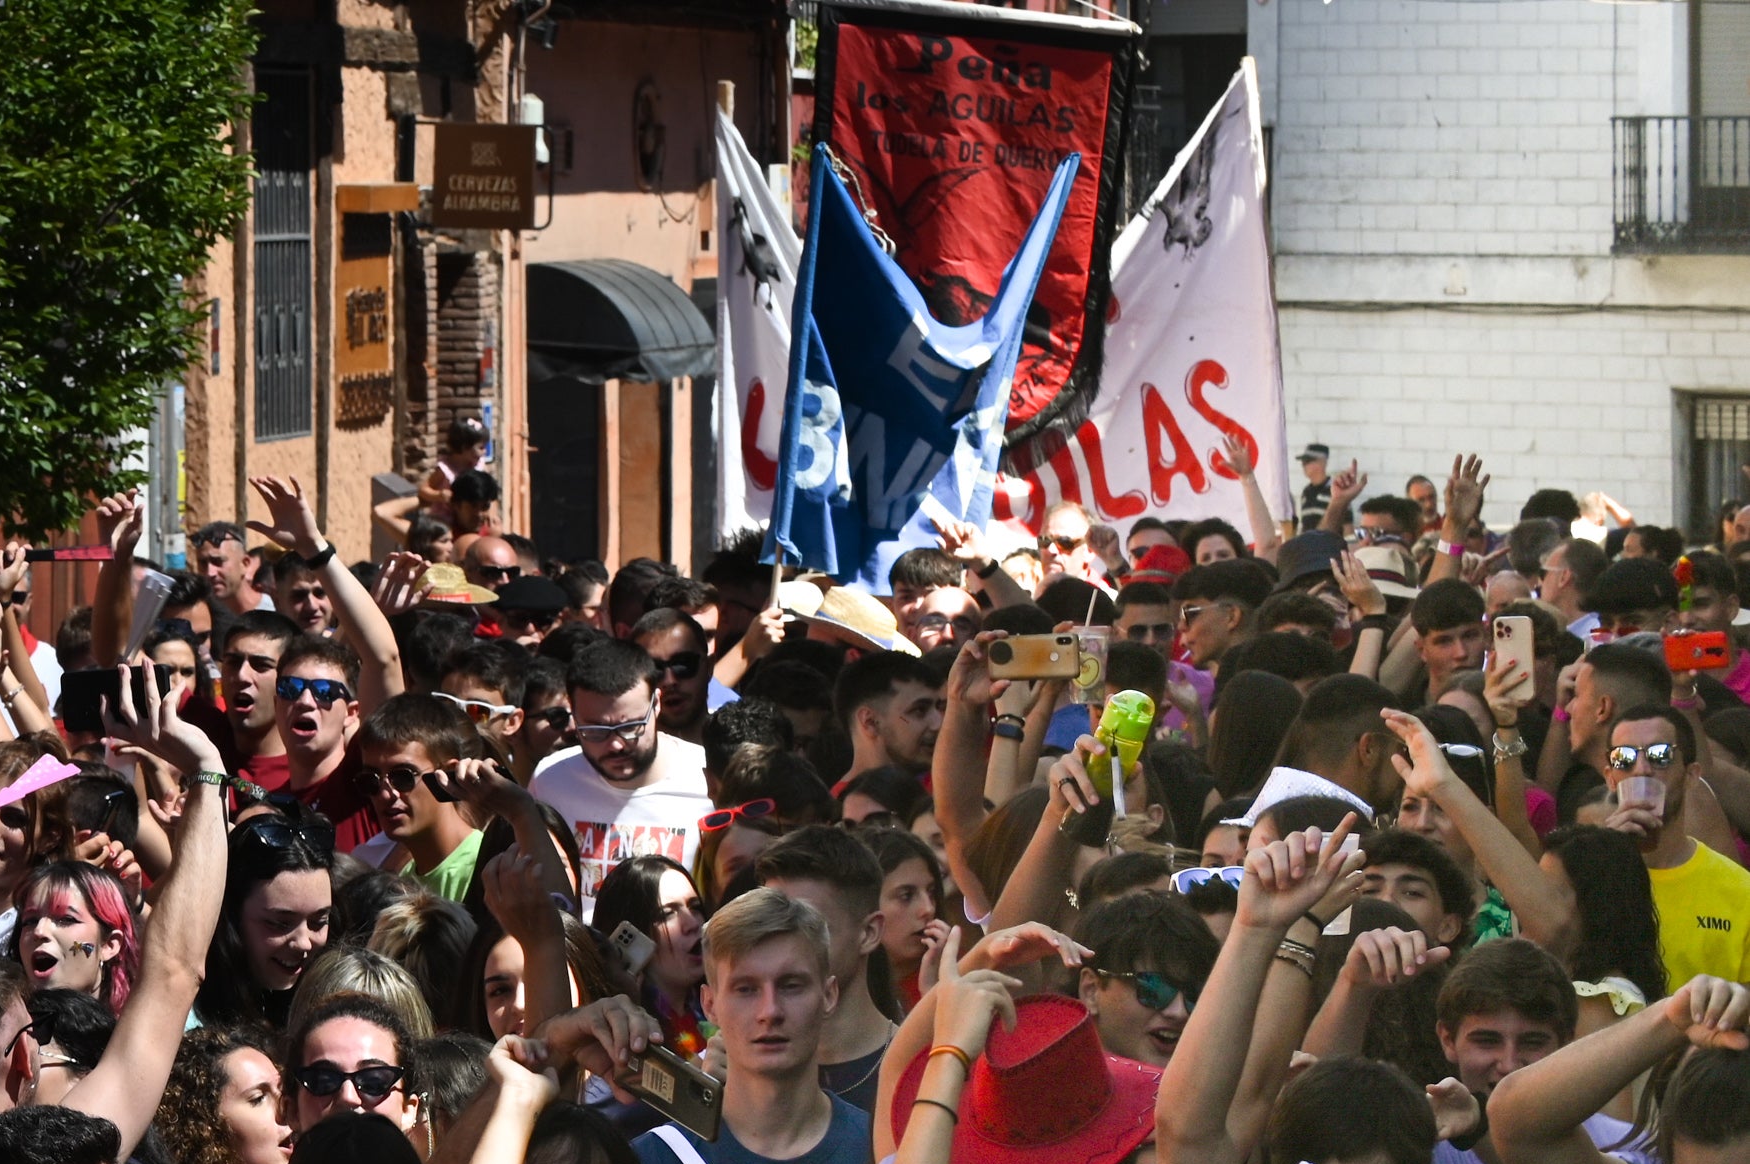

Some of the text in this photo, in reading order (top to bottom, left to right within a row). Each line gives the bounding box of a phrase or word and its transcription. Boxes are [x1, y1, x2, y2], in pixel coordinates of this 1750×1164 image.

[899, 37, 1052, 90] Peña
[856, 82, 1077, 134] los AGUILAS
[871, 131, 947, 161] TUDELA
[958, 141, 985, 163] DE
[449, 174, 517, 192] CERVEZAS
[443, 194, 520, 212] ALHAMBRA
[1696, 915, 1731, 932] XIMO
